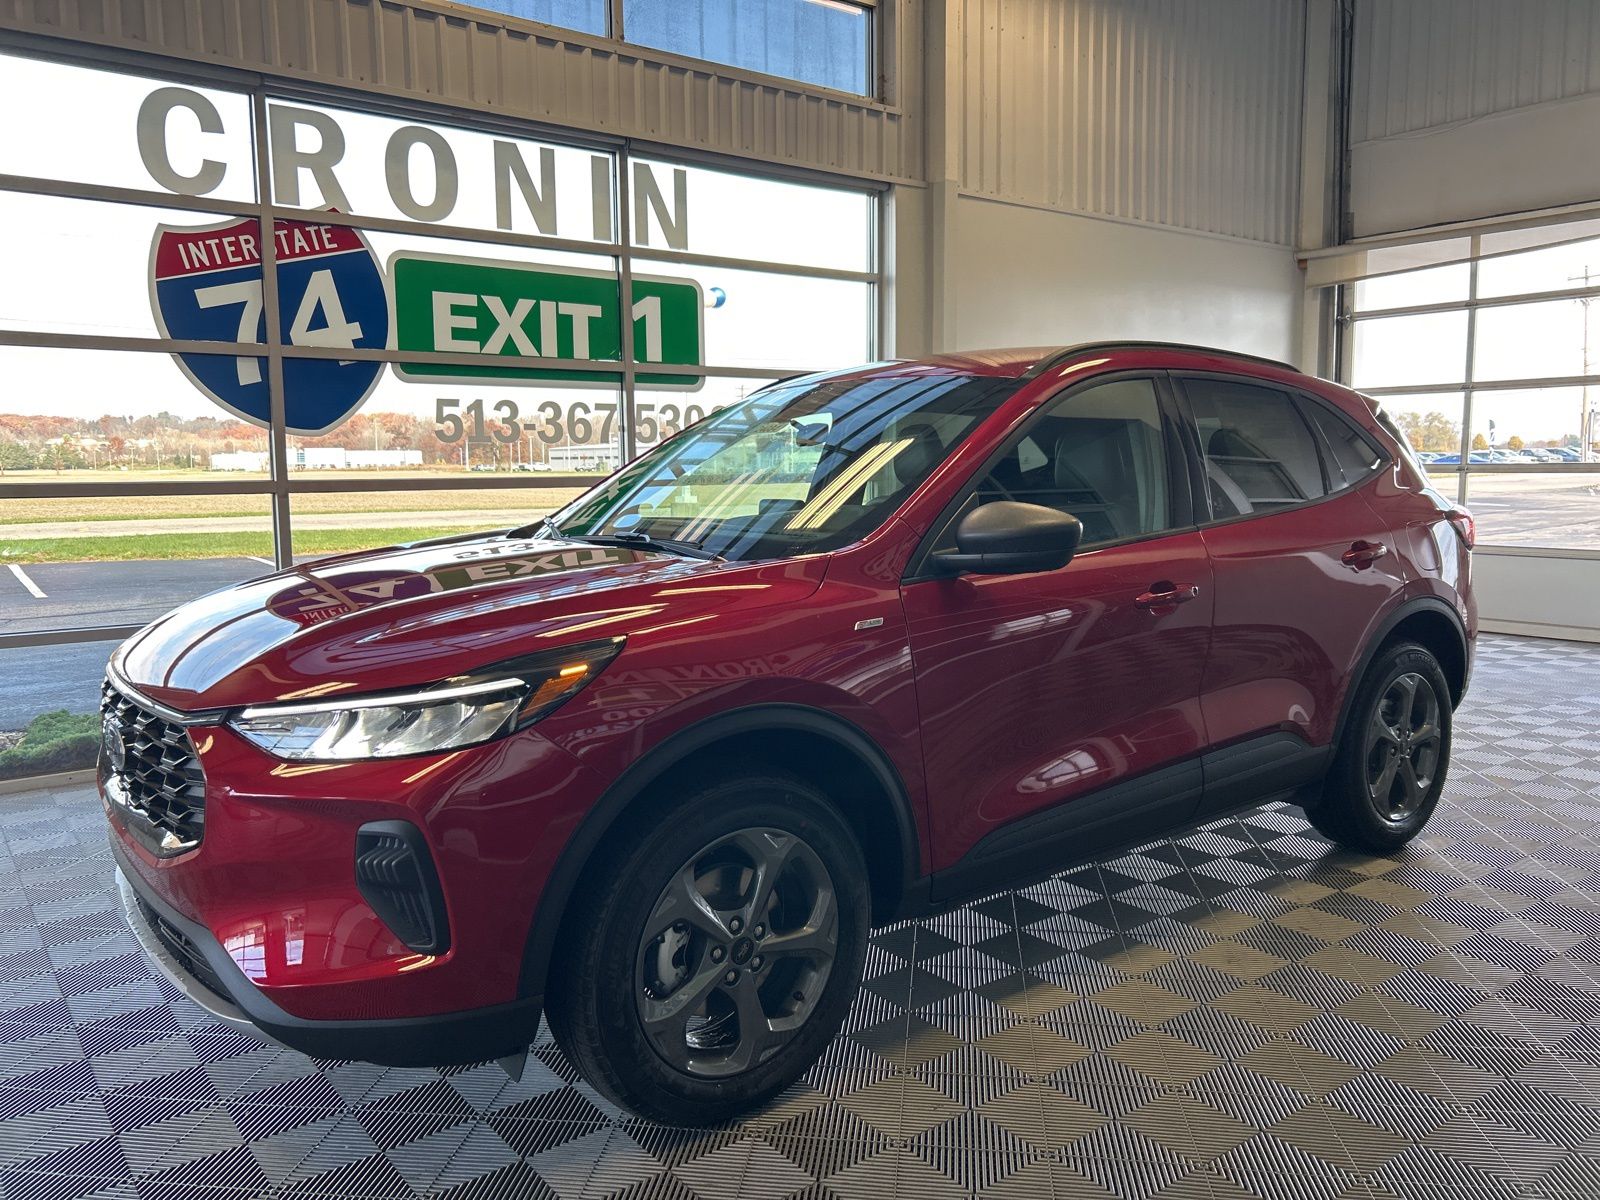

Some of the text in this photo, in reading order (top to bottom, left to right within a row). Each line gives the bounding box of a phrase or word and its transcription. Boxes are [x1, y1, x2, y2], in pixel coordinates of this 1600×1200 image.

[136, 86, 689, 250] CRONIN
[177, 225, 338, 270] INTERTATE
[193, 269, 364, 386] 74
[432, 290, 662, 362] EXIT 1
